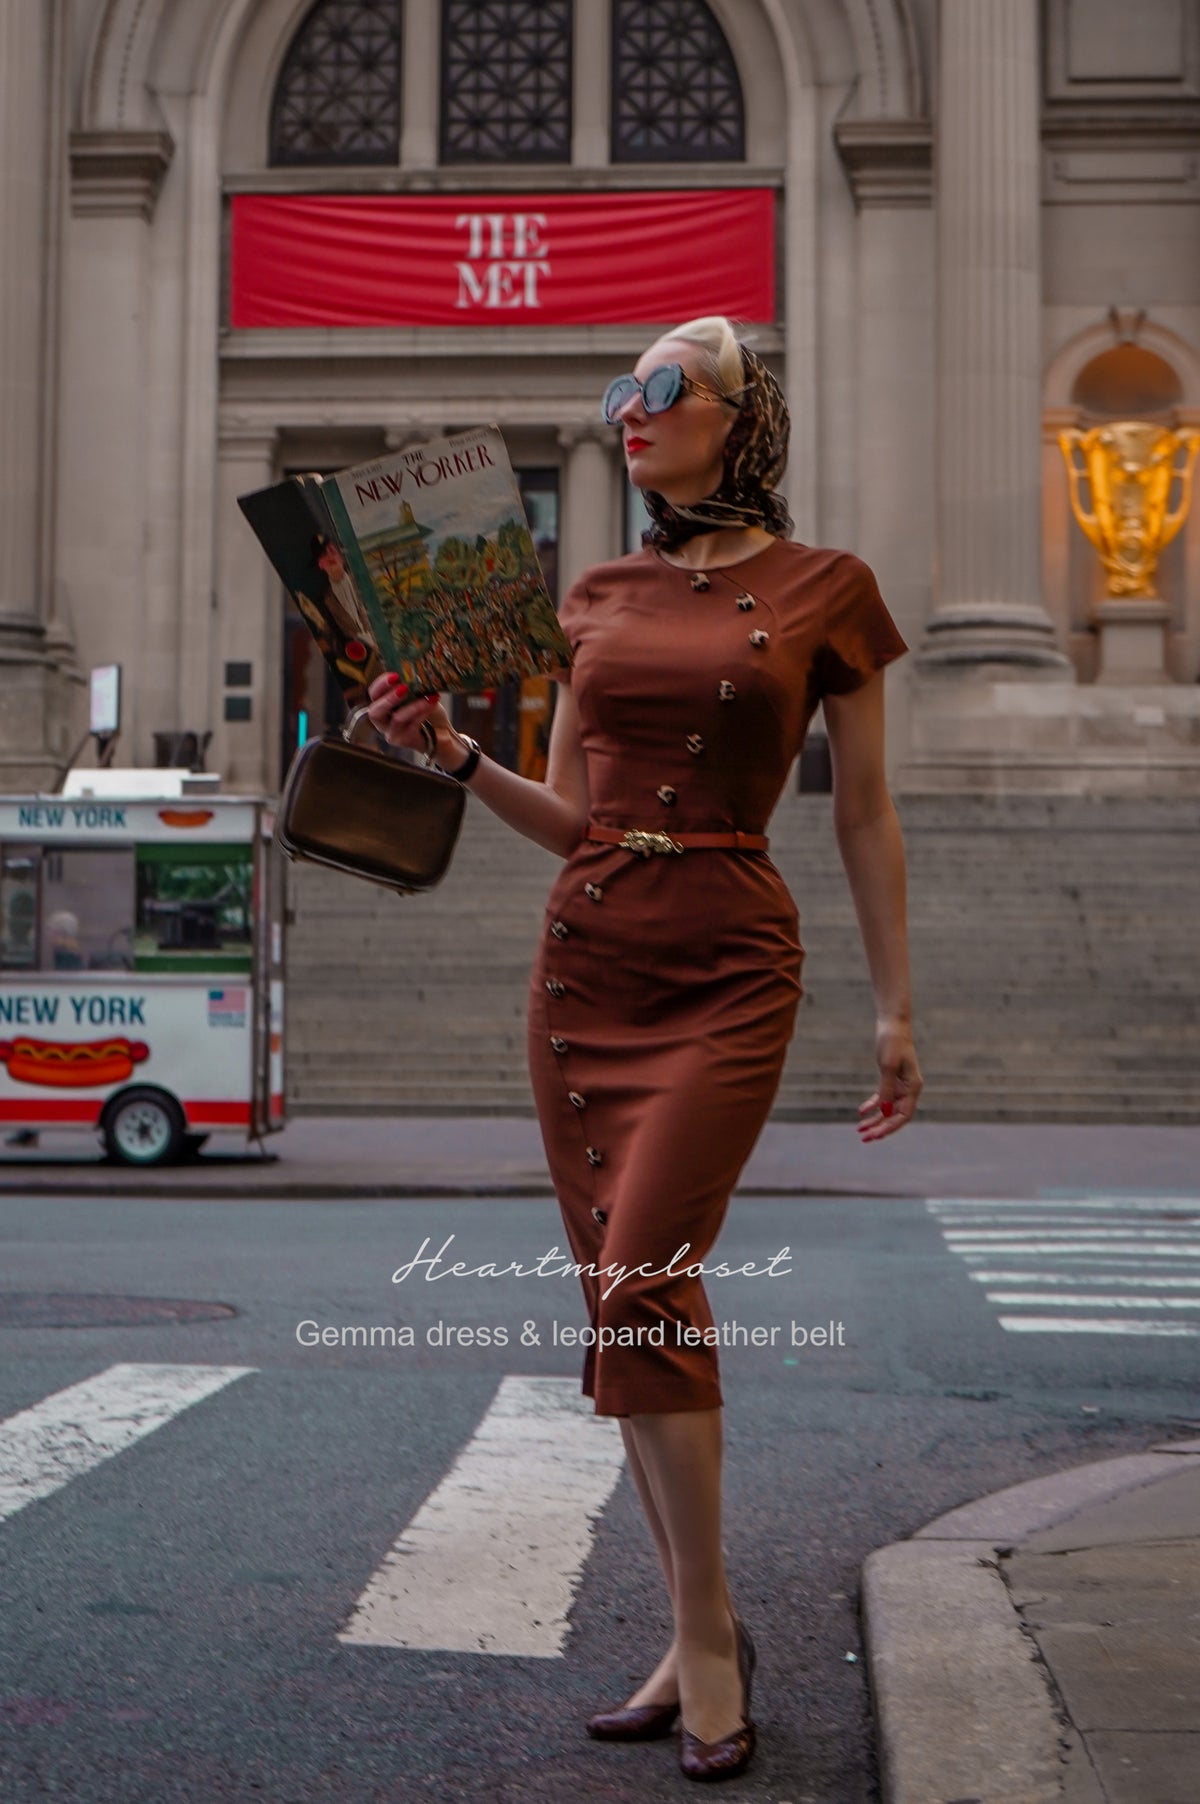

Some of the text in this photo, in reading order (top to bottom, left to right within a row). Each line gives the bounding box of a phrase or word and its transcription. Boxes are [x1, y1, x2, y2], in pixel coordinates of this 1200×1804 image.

[455, 213, 549, 259] THE
[454, 261, 552, 308] MET
[355, 444, 495, 506] NEW YORKER
[402, 450, 425, 465] THE
[19, 806, 127, 828] NEW YORK
[0, 996, 146, 1025] NEW YORK
